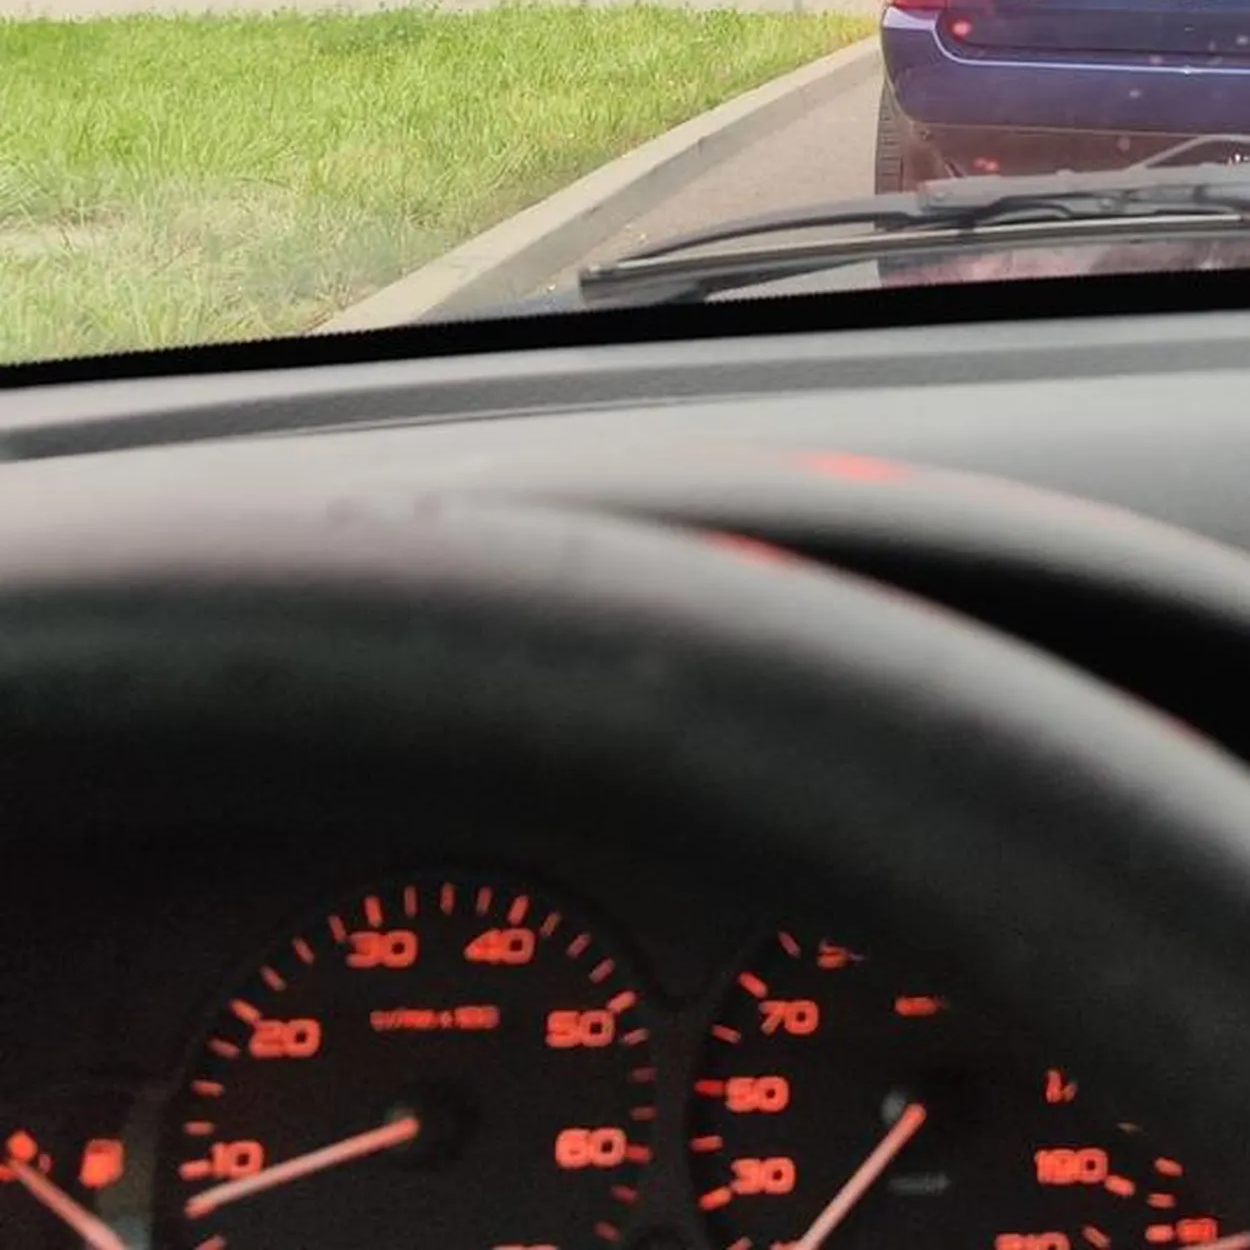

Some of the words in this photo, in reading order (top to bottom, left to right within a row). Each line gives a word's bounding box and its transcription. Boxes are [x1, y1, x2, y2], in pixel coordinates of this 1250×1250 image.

[348, 930, 417, 968] 30
[465, 928, 535, 964] 40
[546, 1009, 615, 1048] 50
